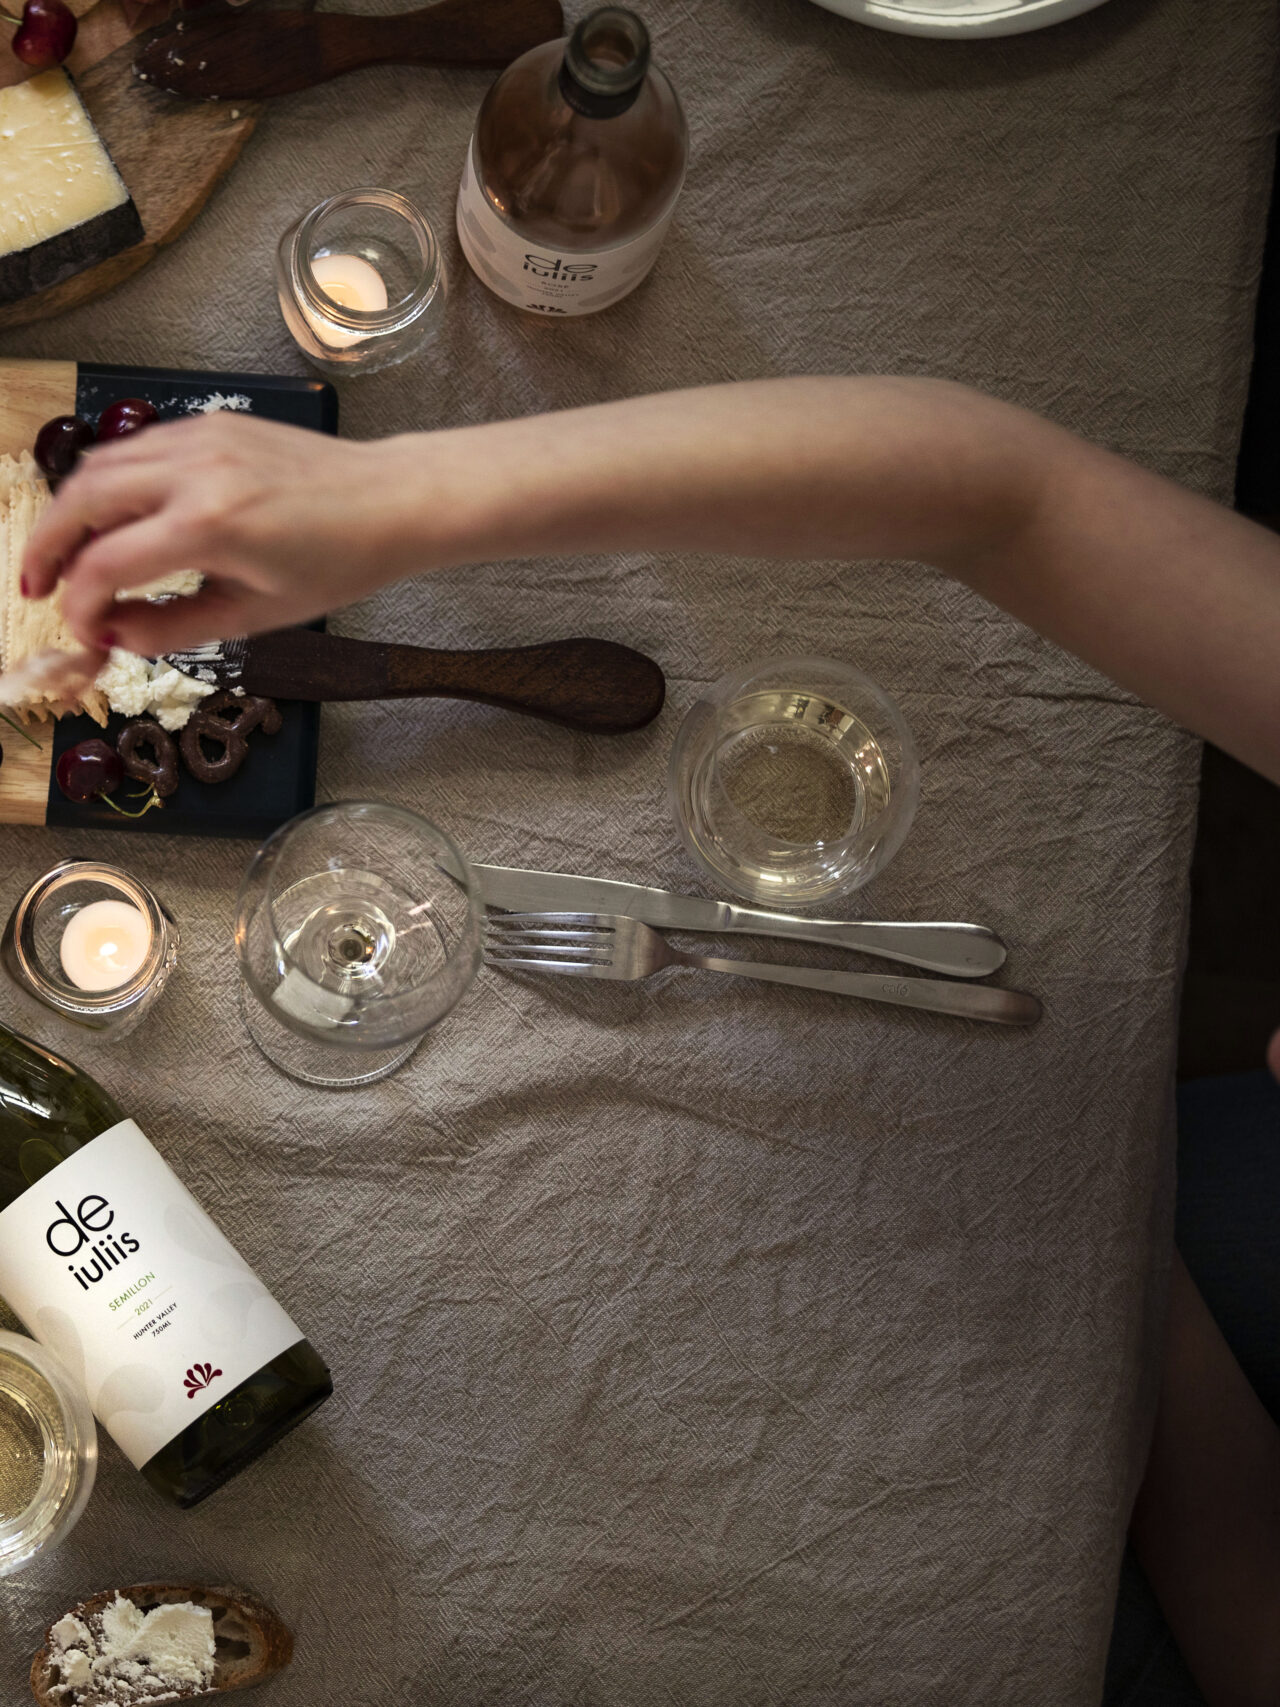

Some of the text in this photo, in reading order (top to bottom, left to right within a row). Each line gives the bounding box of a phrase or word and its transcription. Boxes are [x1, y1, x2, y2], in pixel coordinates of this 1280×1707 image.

[523, 262, 594, 281] iuliis
[525, 254, 598, 273] de
[46, 1195, 114, 1257] de
[68, 1232, 140, 1291] iuliis
[108, 1271, 155, 1311] SEMILLON
[133, 1302, 178, 1340] HUNTER VALLEY
[134, 1298, 153, 1316] 2021
[151, 1320, 172, 1338] 750ML
